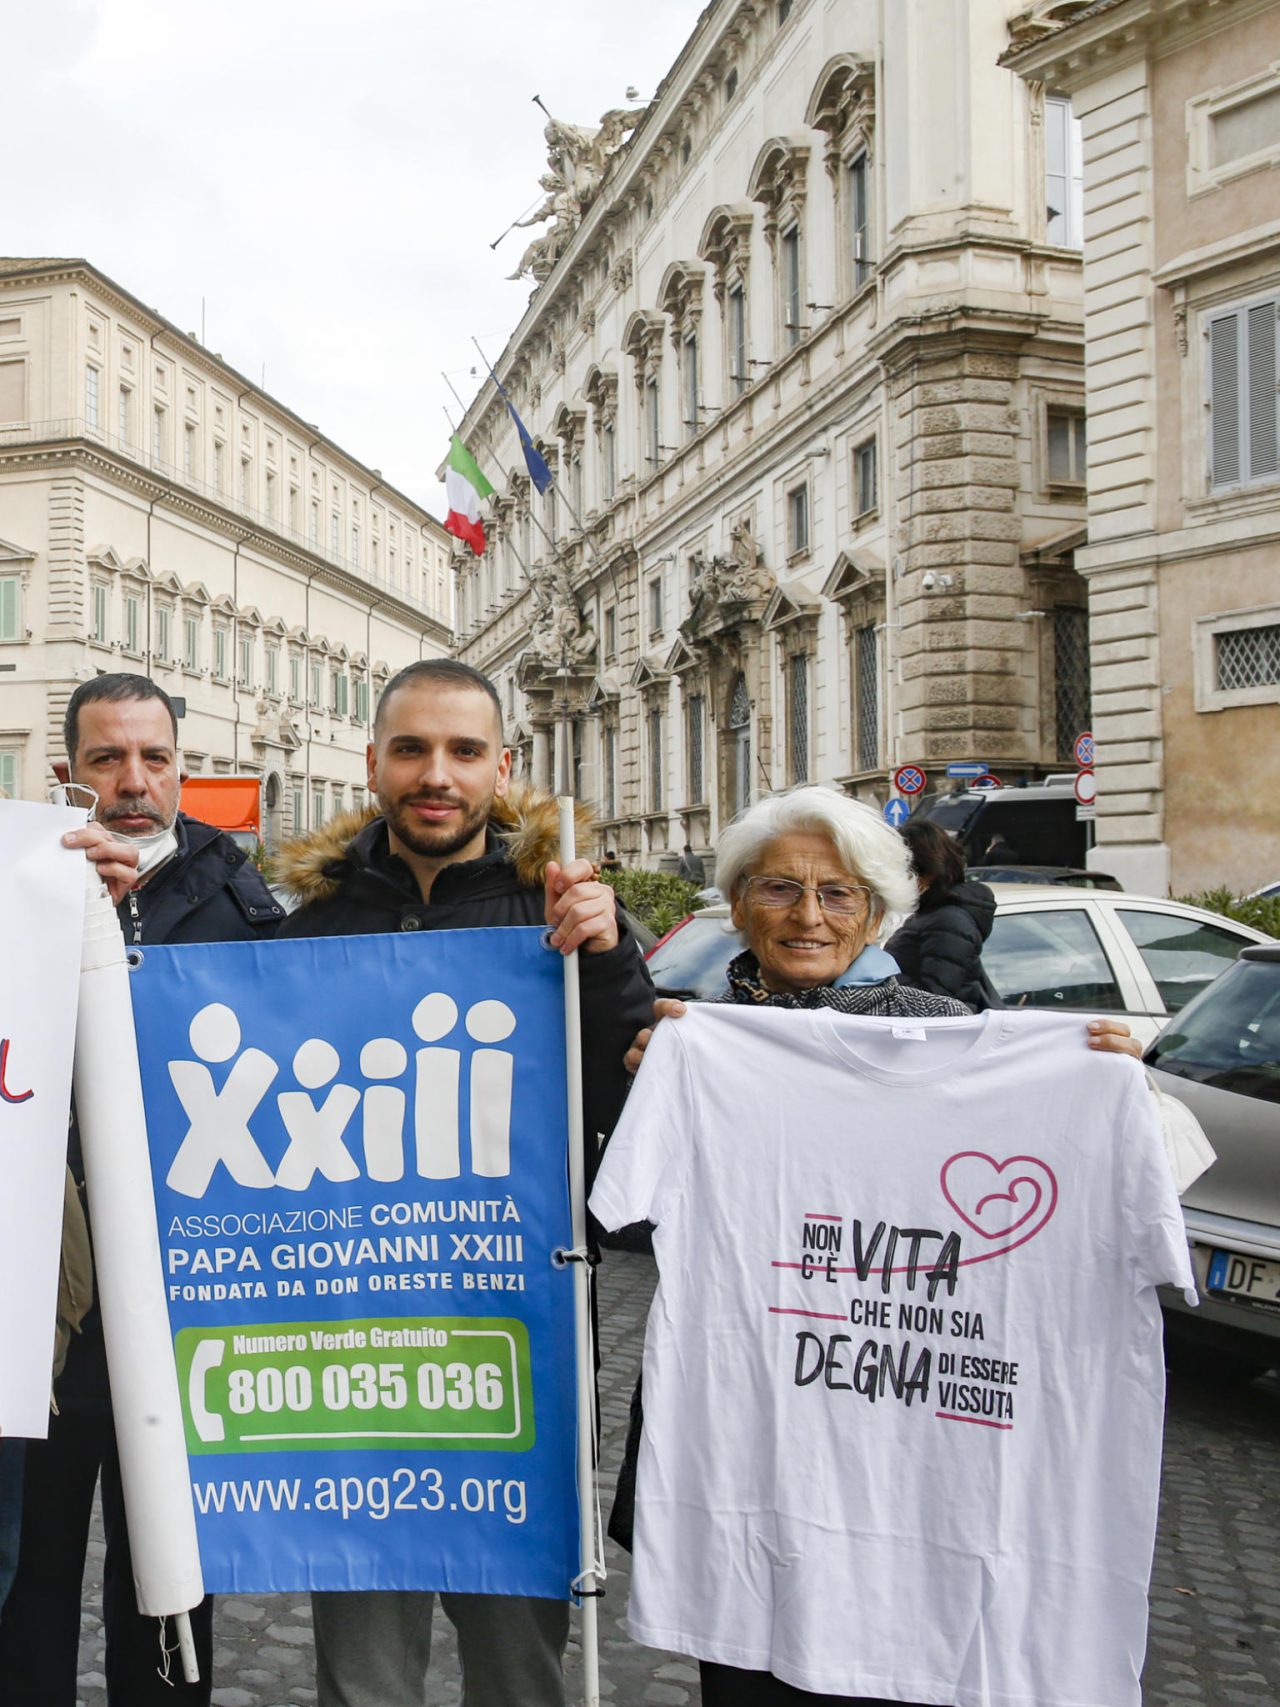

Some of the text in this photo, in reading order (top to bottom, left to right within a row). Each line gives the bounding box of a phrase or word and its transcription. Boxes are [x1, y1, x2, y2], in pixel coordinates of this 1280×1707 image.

[167, 1194, 521, 1238] ASSOCIAZIONE COMUNITÀ
[167, 1234, 524, 1275] PAPA GIOVANNI XXIII
[802, 1222, 842, 1253] NON
[851, 1218, 962, 1303] VITA
[1228, 1258, 1266, 1292] DF
[169, 1271, 526, 1302] FONDATA DA DON ORESTE BENZI
[850, 1298, 985, 1341] CHE NON SIA
[232, 1325, 449, 1356] Numero Verde Gratuito
[227, 1360, 505, 1415] 800 035 036
[793, 1331, 932, 1408] DEGNA
[938, 1352, 1019, 1386] DI ESSERE
[937, 1380, 1014, 1420] VISSUTA
[193, 1466, 527, 1525] www.apg23.org
